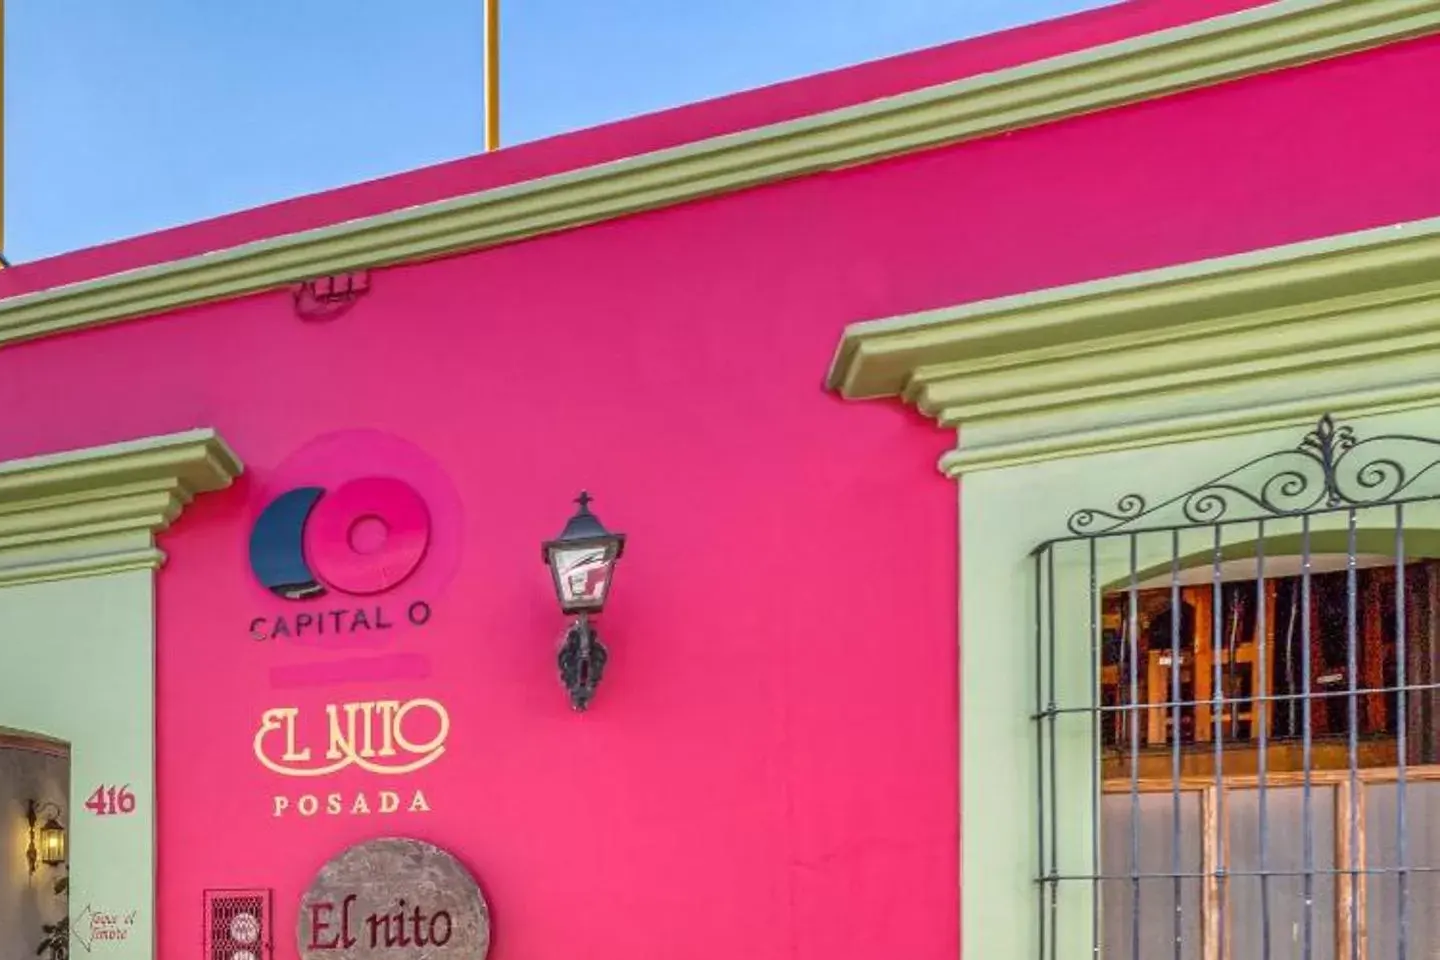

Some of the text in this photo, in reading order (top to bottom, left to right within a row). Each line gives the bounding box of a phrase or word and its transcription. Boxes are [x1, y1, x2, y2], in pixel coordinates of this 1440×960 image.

[250, 600, 431, 641] CAPITAL O
[253, 698, 450, 776] EL NITO
[85, 783, 136, 816] 416
[272, 789, 432, 818] POSADA
[306, 894, 453, 950] El nito
